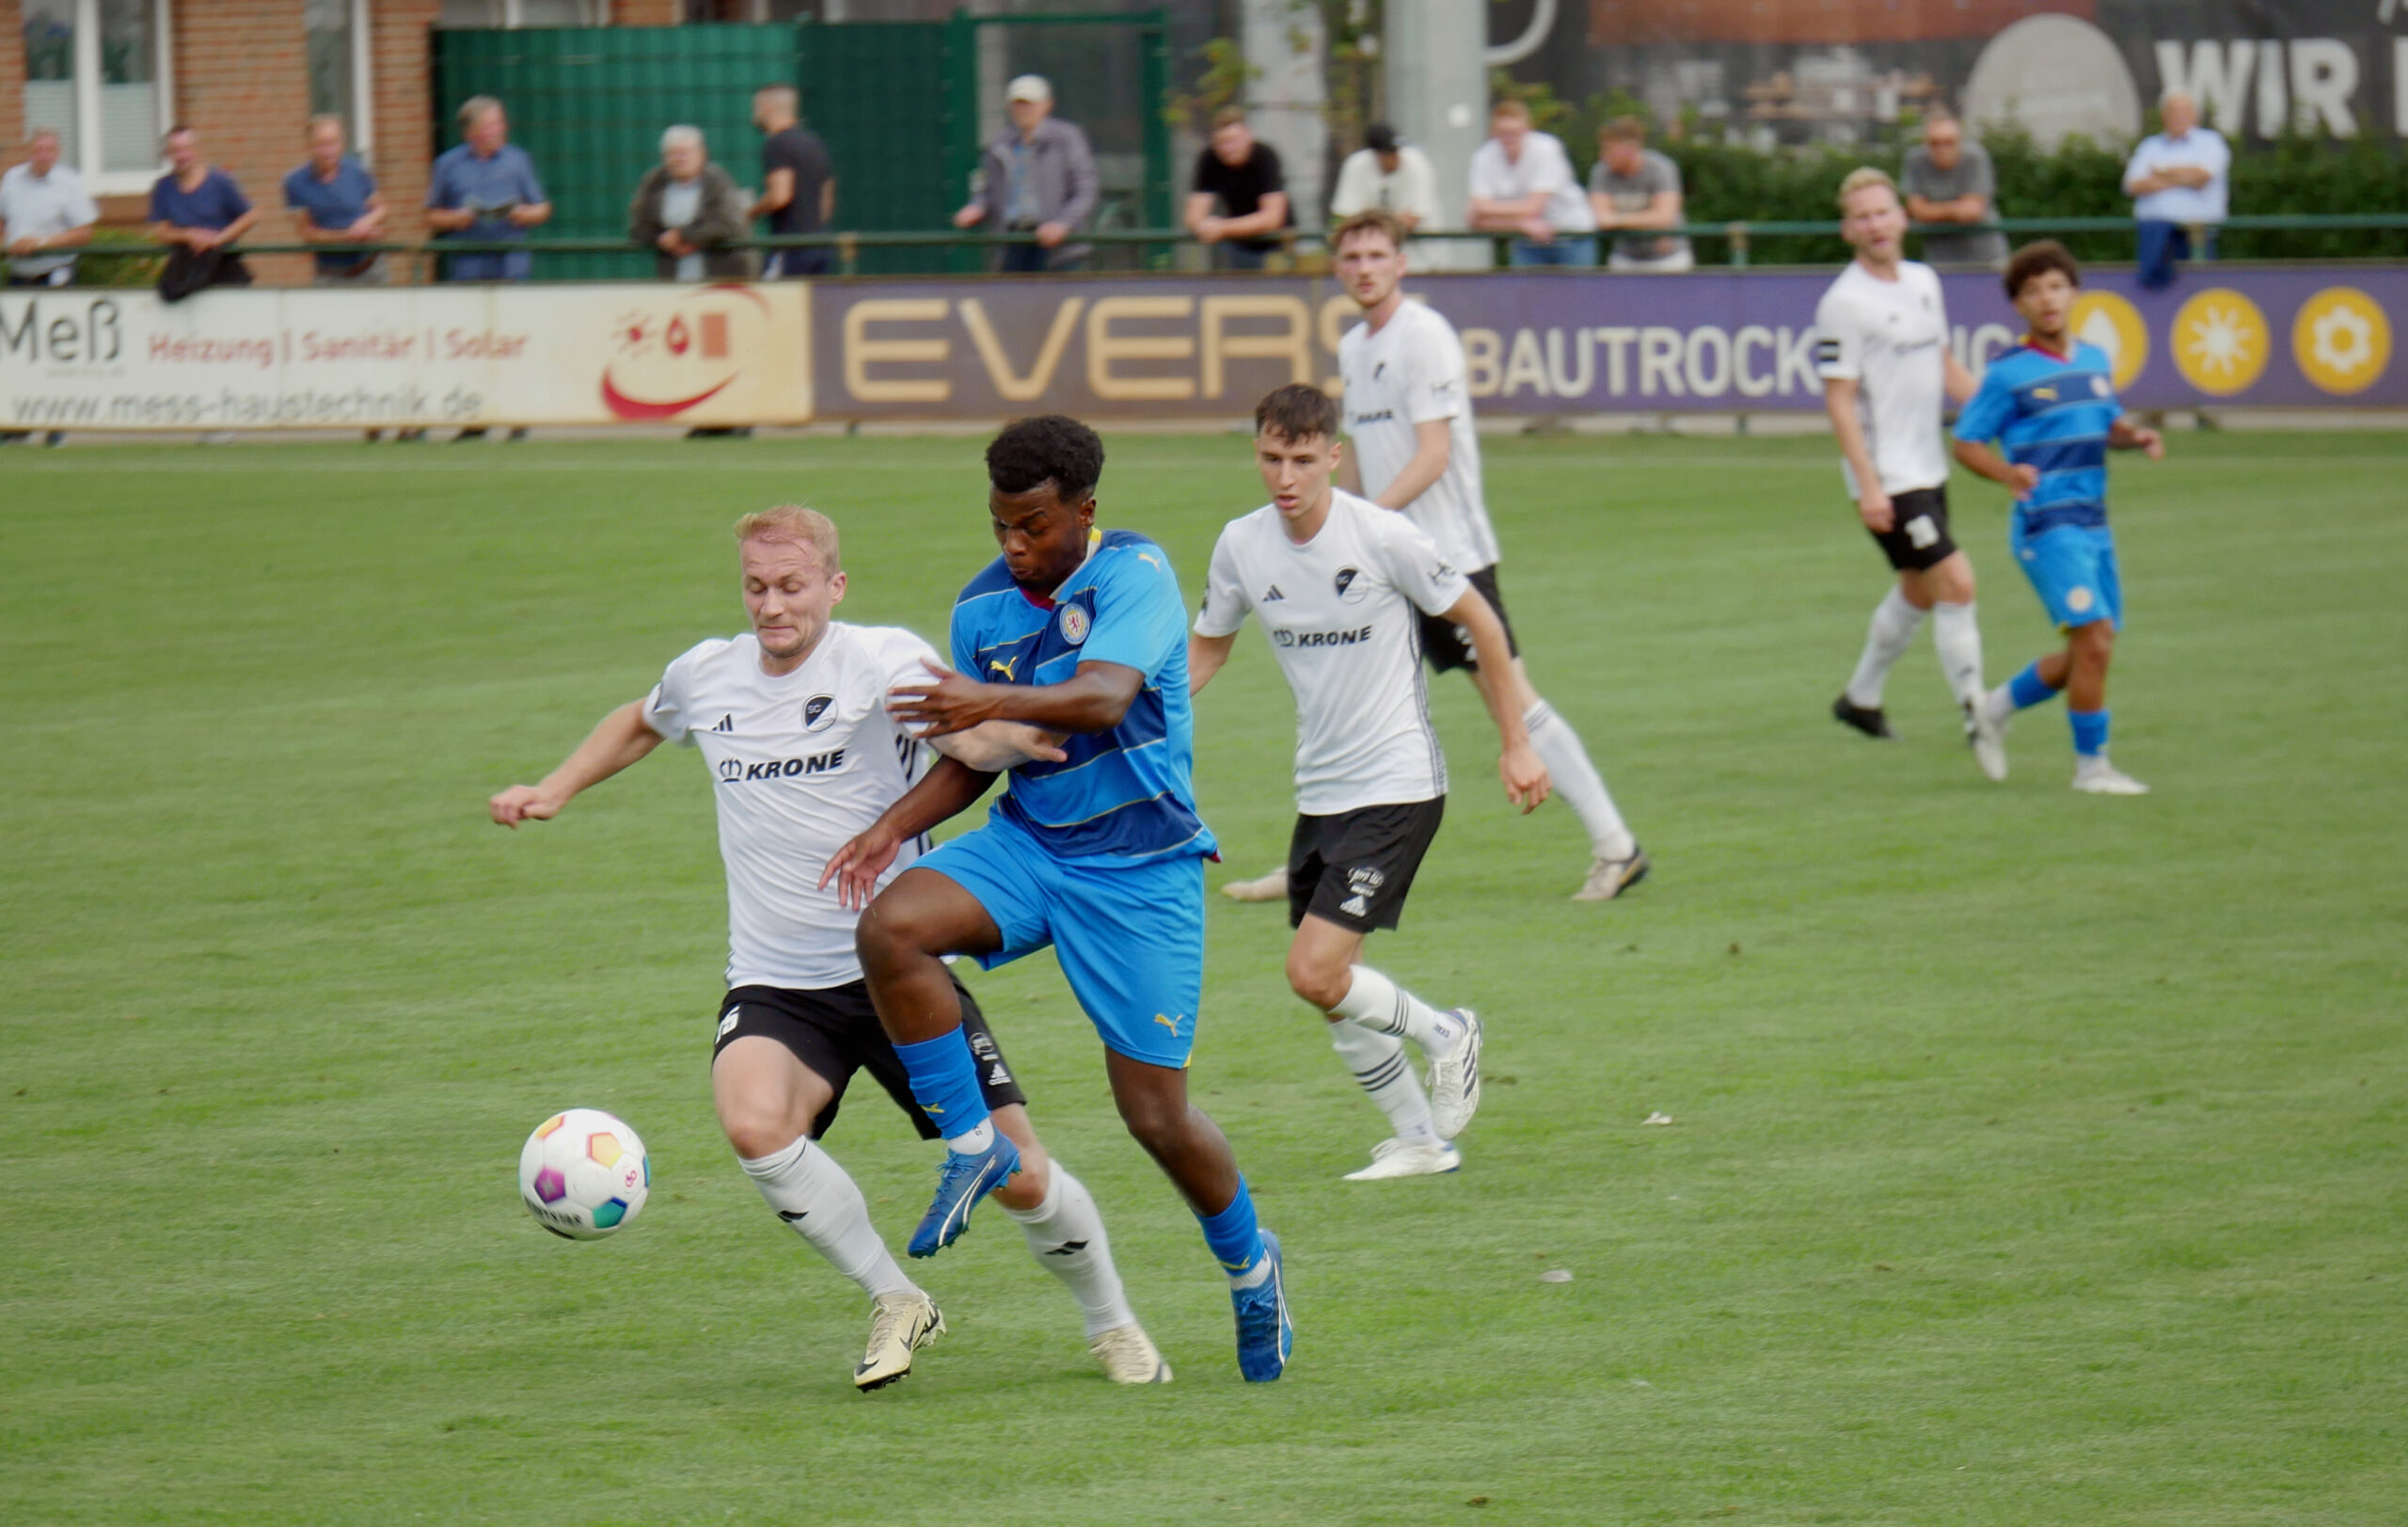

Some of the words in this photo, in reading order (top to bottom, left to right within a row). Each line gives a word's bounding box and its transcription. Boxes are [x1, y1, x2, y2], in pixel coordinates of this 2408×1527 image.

[2155, 38, 2358, 139] WIR
[0, 296, 120, 363] Meß
[149, 331, 273, 370] Heizung
[302, 329, 415, 362] Sanitär
[446, 328, 529, 361] Solar
[1298, 624, 1373, 647] KRONE
[745, 749, 845, 782] KRONE
